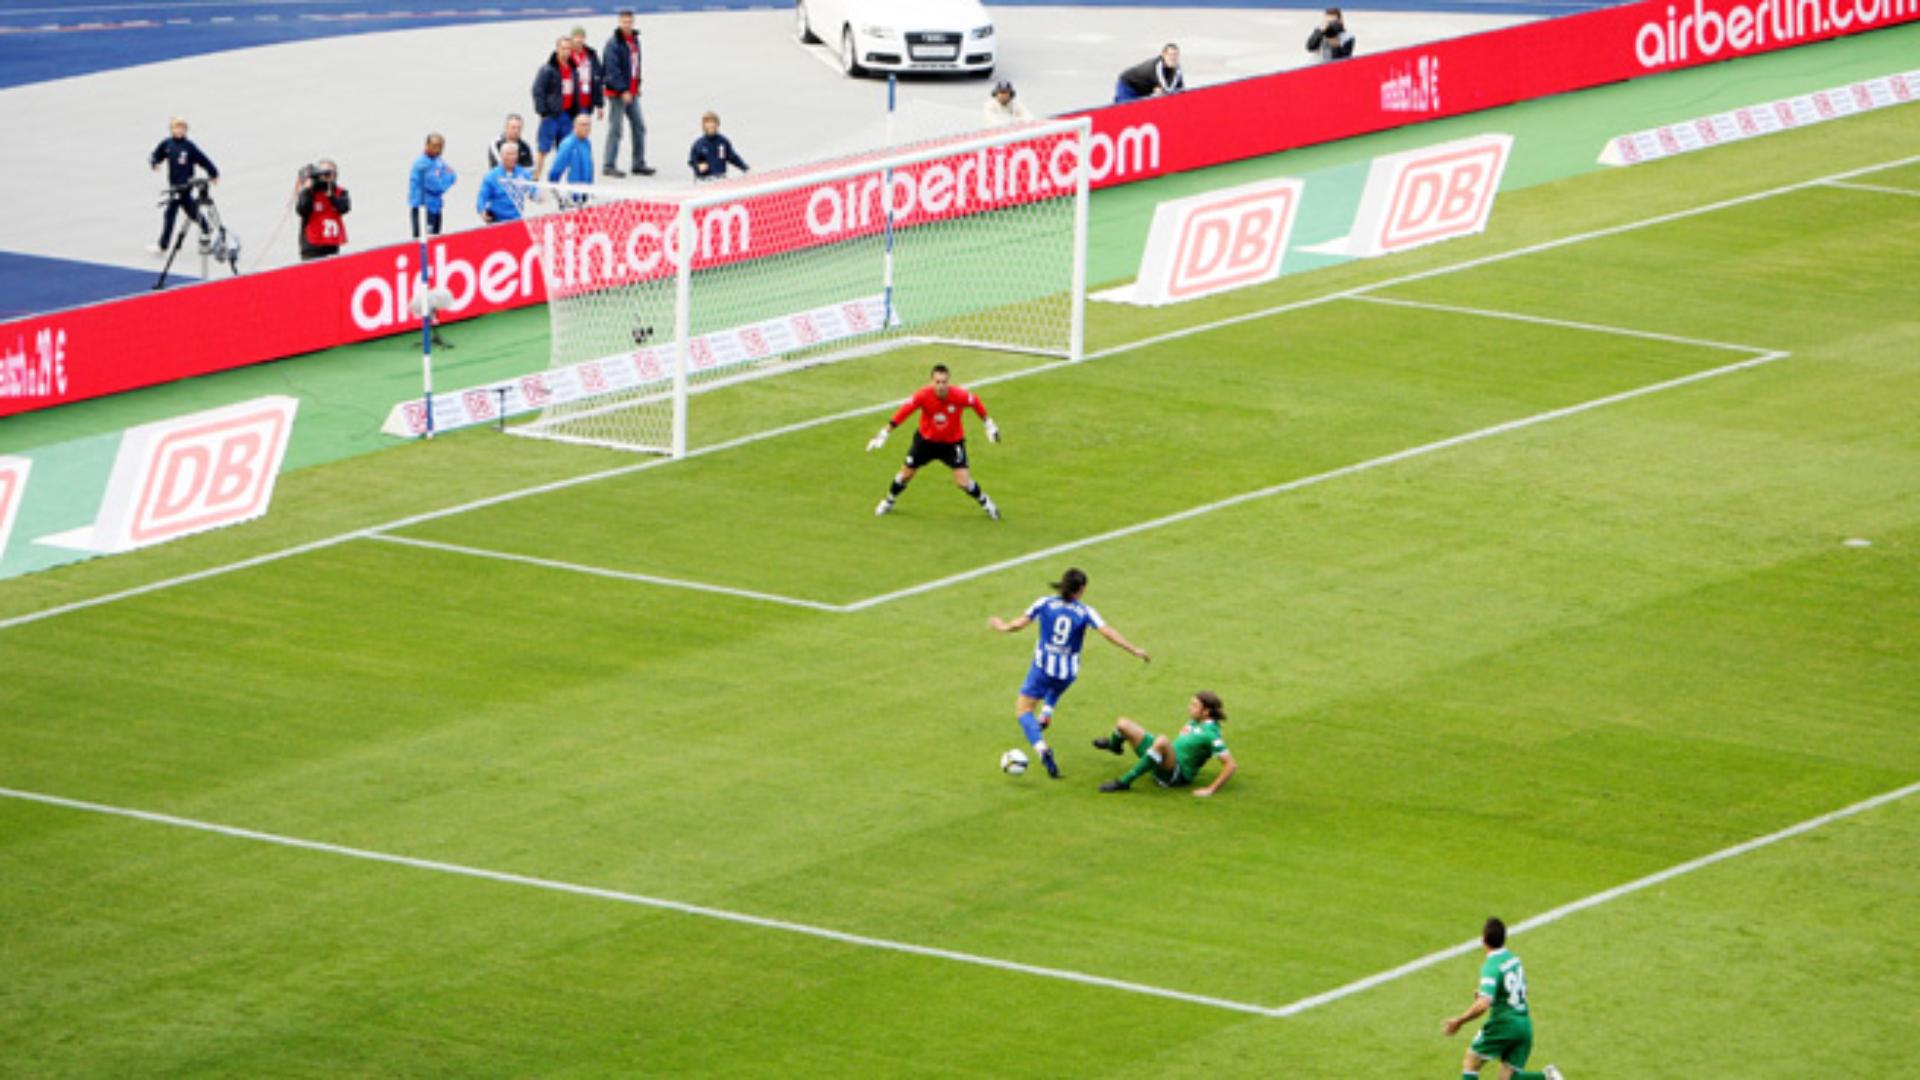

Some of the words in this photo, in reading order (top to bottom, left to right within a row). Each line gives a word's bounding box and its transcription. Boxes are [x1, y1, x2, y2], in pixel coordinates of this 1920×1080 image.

[1396, 164, 1483, 231] DB
[1185, 207, 1274, 280] DB
[152, 432, 261, 520] DB
[1053, 615, 1071, 645] 9
